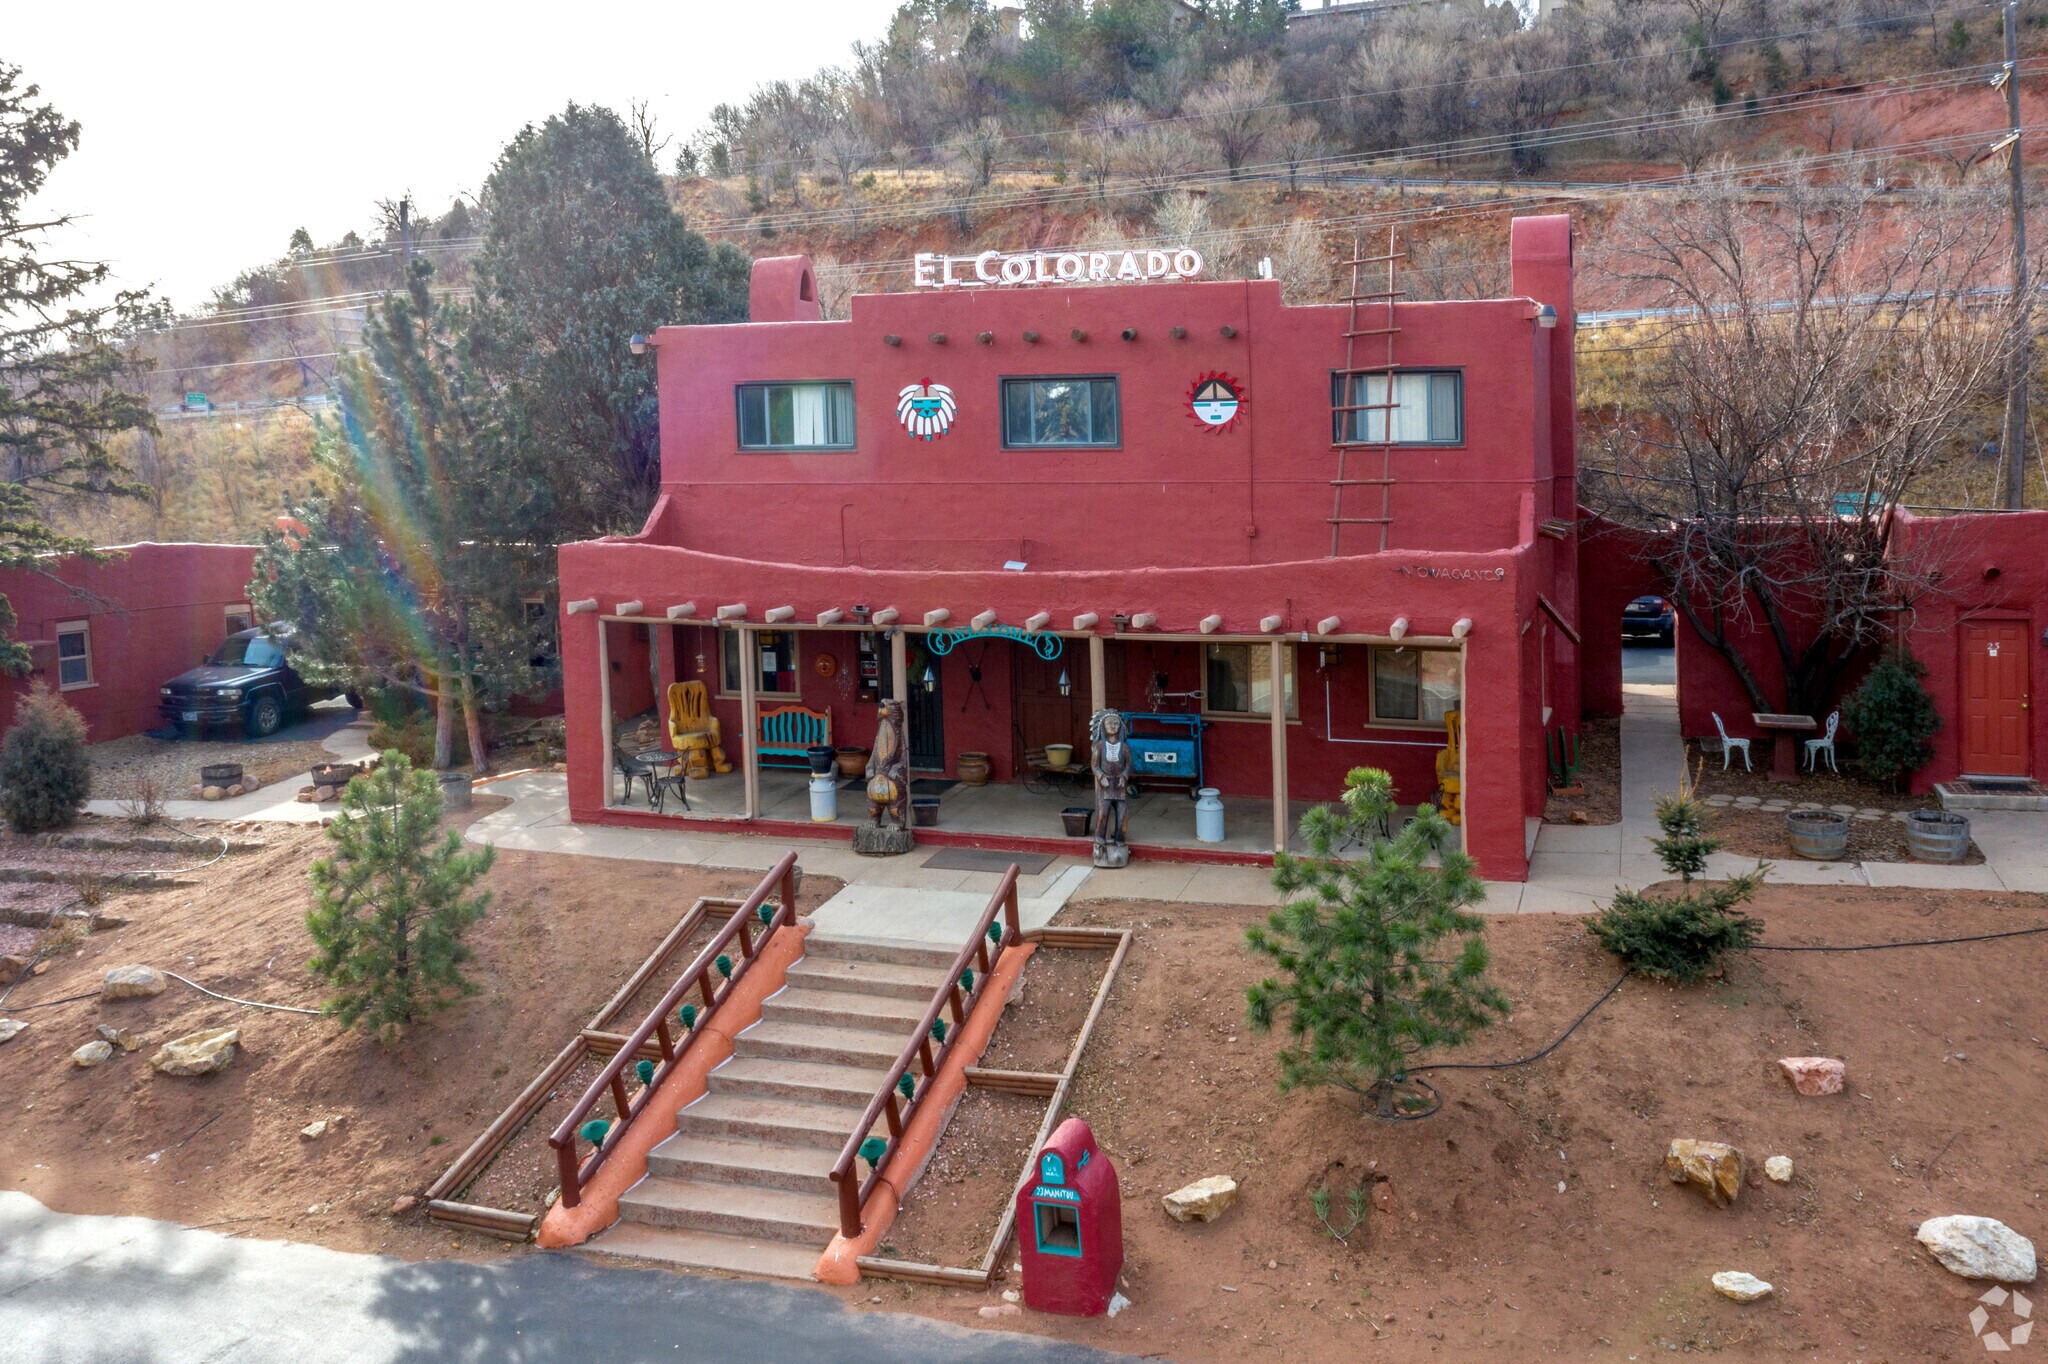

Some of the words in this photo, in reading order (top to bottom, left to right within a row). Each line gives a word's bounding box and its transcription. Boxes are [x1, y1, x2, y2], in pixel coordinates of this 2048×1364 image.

[914, 252, 961, 287] EL
[1431, 567, 1504, 581] VACANC
[952, 623, 1035, 645] WELCOME
